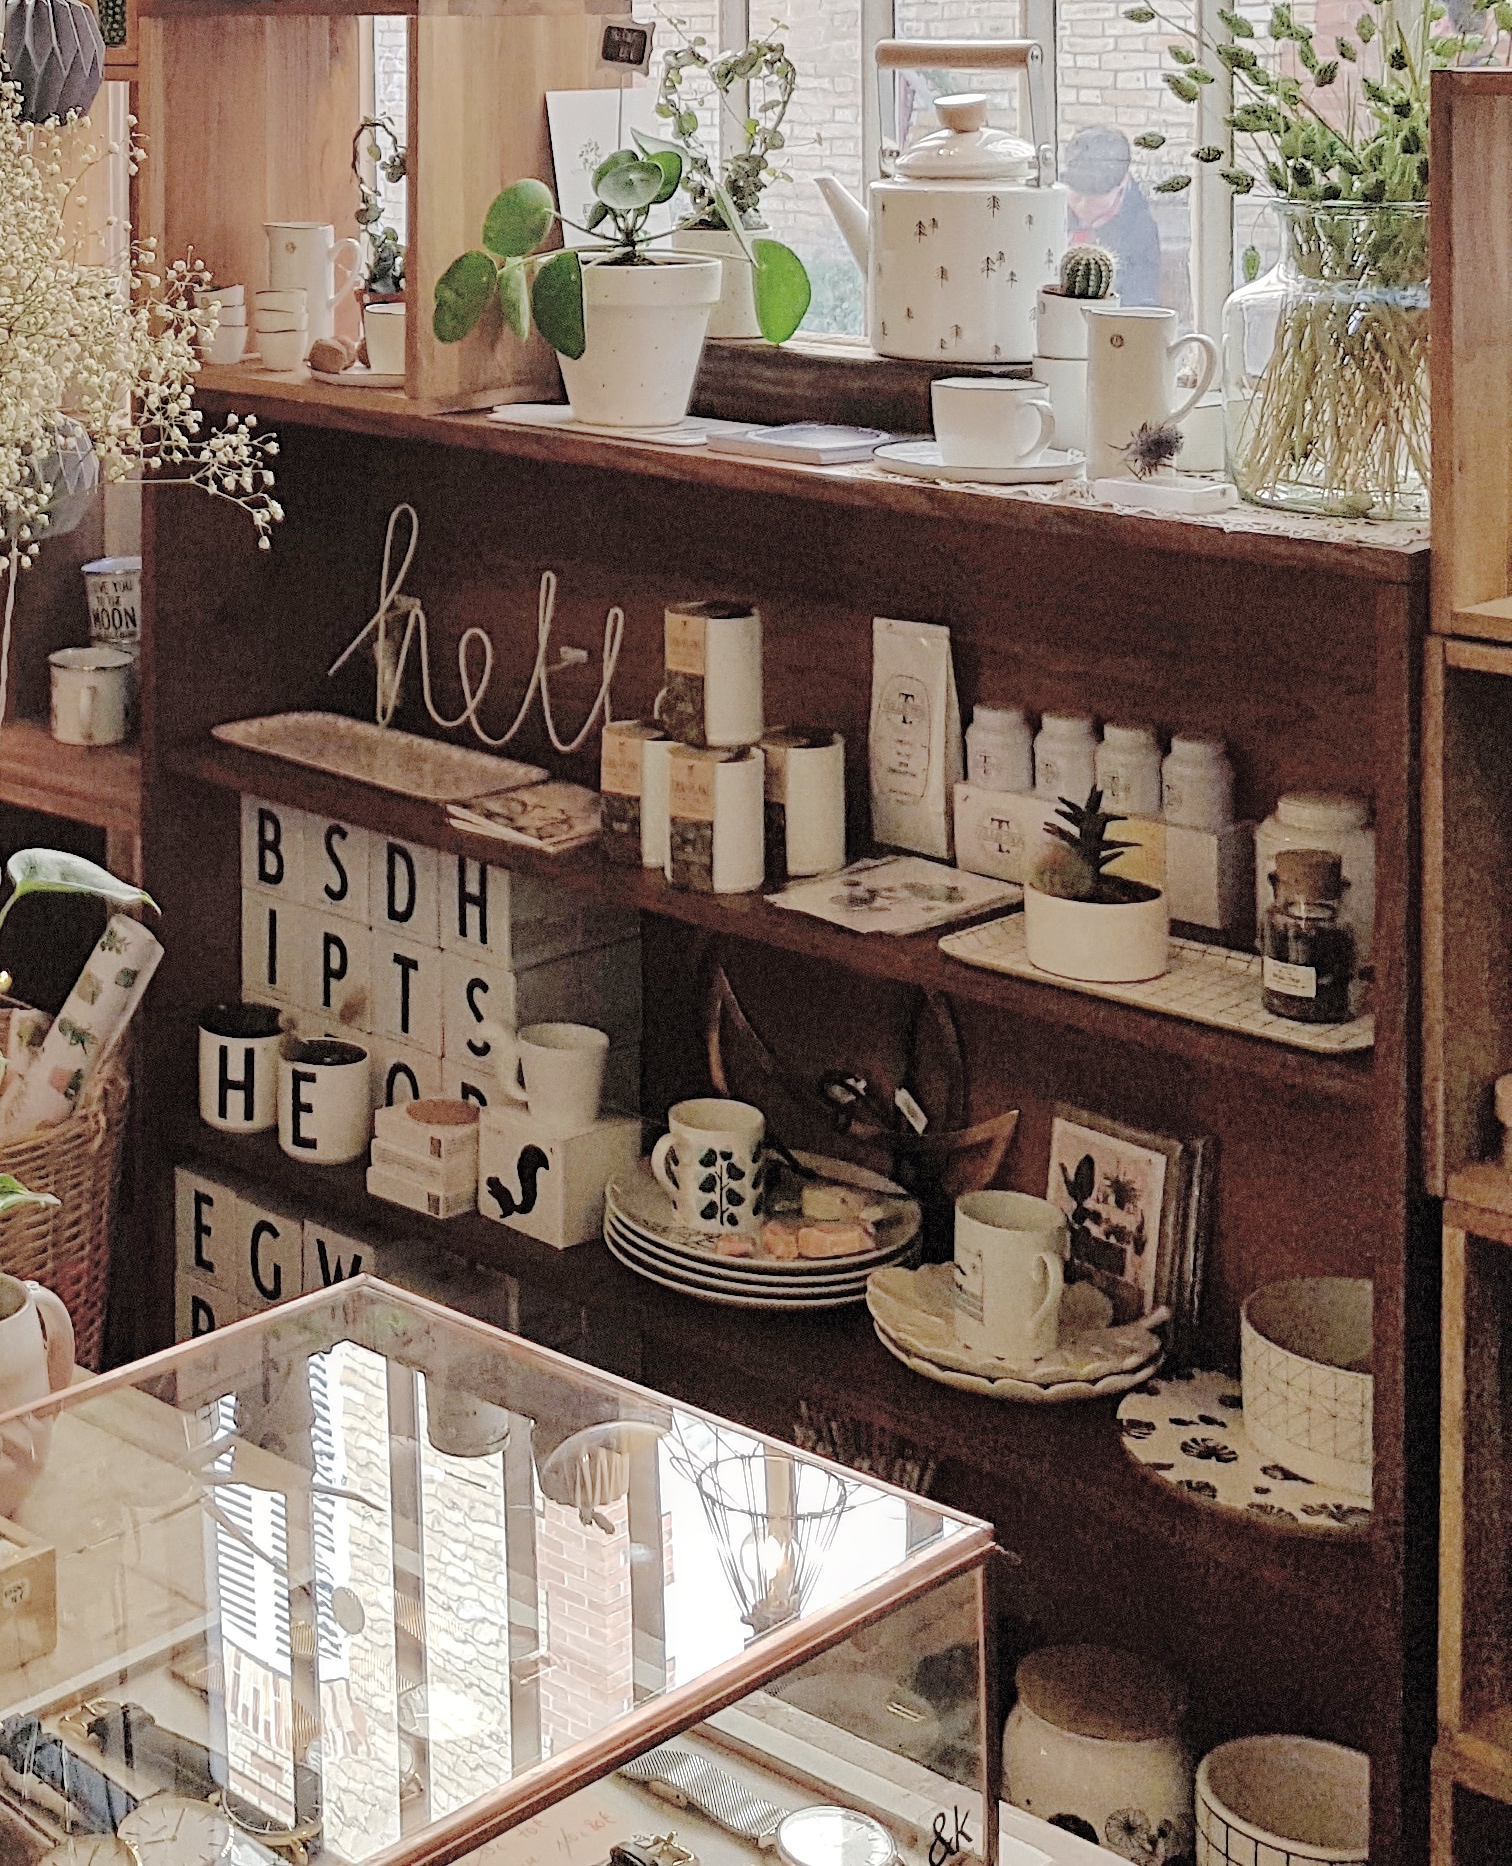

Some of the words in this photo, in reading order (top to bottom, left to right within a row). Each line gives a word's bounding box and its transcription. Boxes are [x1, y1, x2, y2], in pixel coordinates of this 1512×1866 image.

[91, 606, 138, 630] MOON
[328, 503, 670, 753] hell
[218, 1045, 254, 1121] H
[292, 1067, 317, 1150] E
